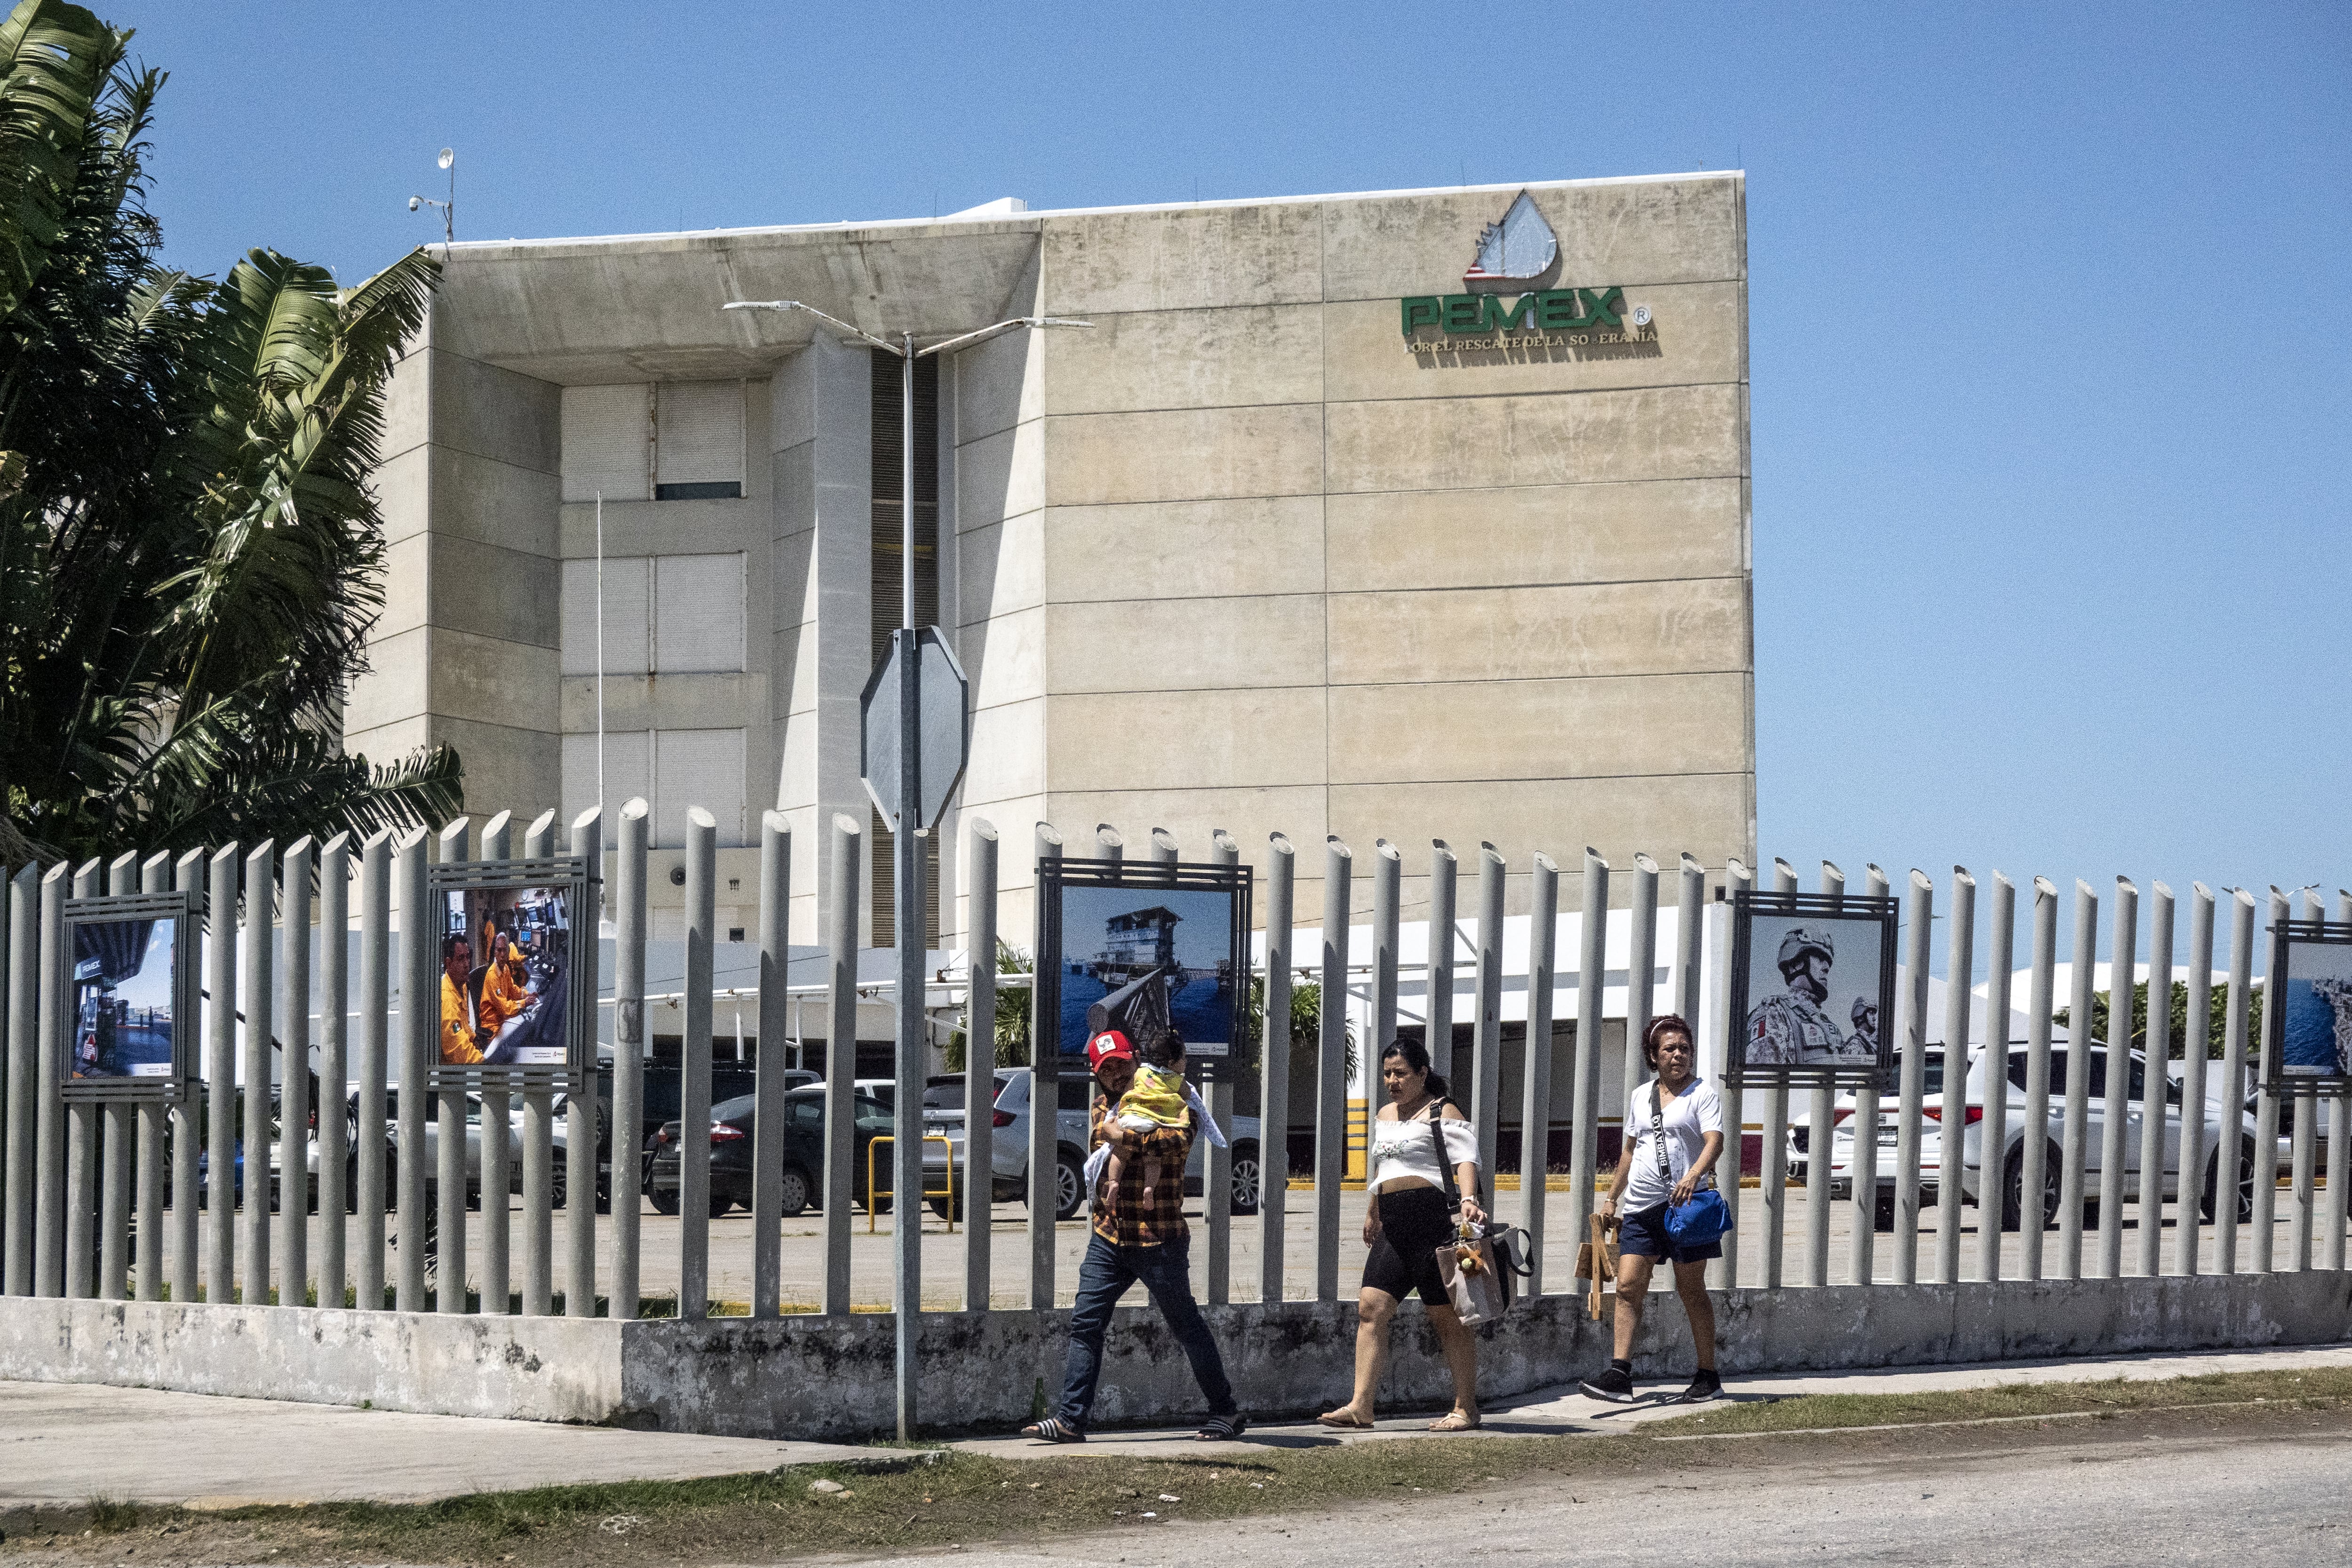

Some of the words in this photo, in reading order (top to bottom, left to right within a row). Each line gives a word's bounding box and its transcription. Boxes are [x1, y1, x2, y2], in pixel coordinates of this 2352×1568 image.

[1401, 286, 1624, 336] PEMEX
[1436, 340, 1452, 351] EL
[1456, 337, 1521, 351] RESCATE
[1523, 335, 1543, 347] DE
[1545, 335, 1565, 346] LA
[1569, 326, 1658, 345] SOERANÍA
